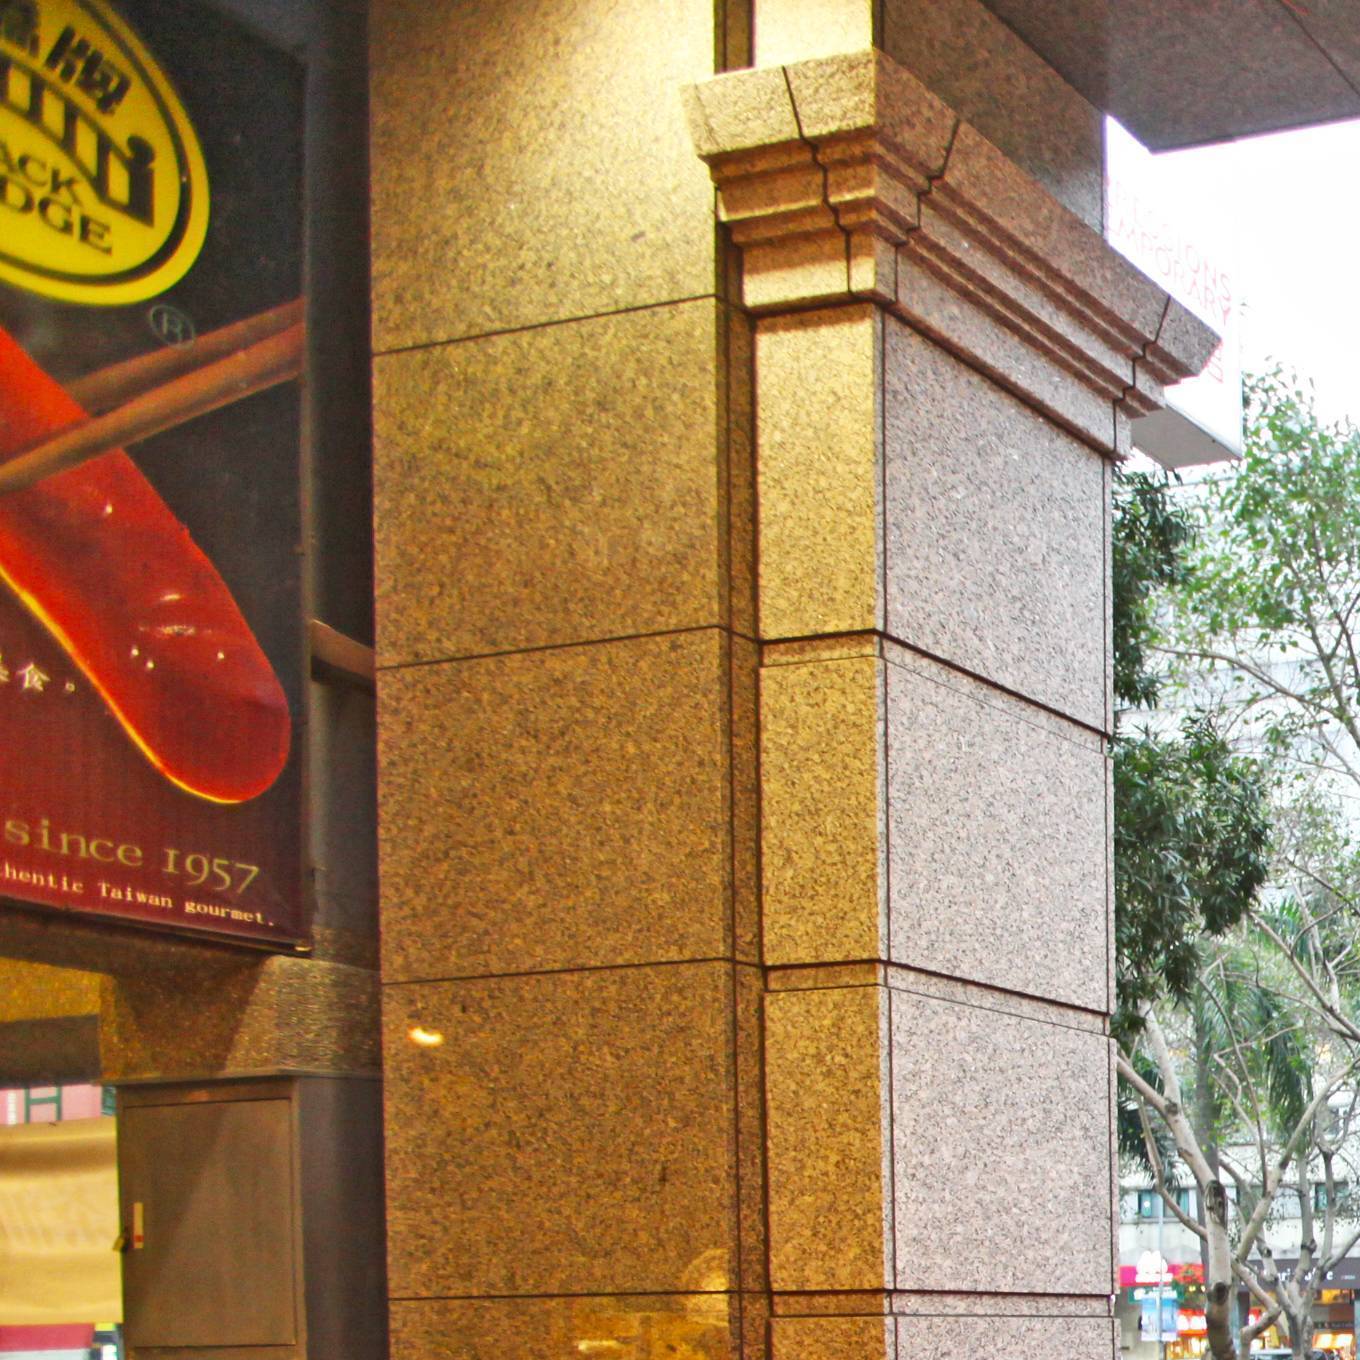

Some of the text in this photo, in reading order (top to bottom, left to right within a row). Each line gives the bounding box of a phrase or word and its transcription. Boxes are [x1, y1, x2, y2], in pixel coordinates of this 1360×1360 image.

[4, 818, 260, 894] since 1957
[0, 861, 276, 927] hentic Taiwan gourmet.
